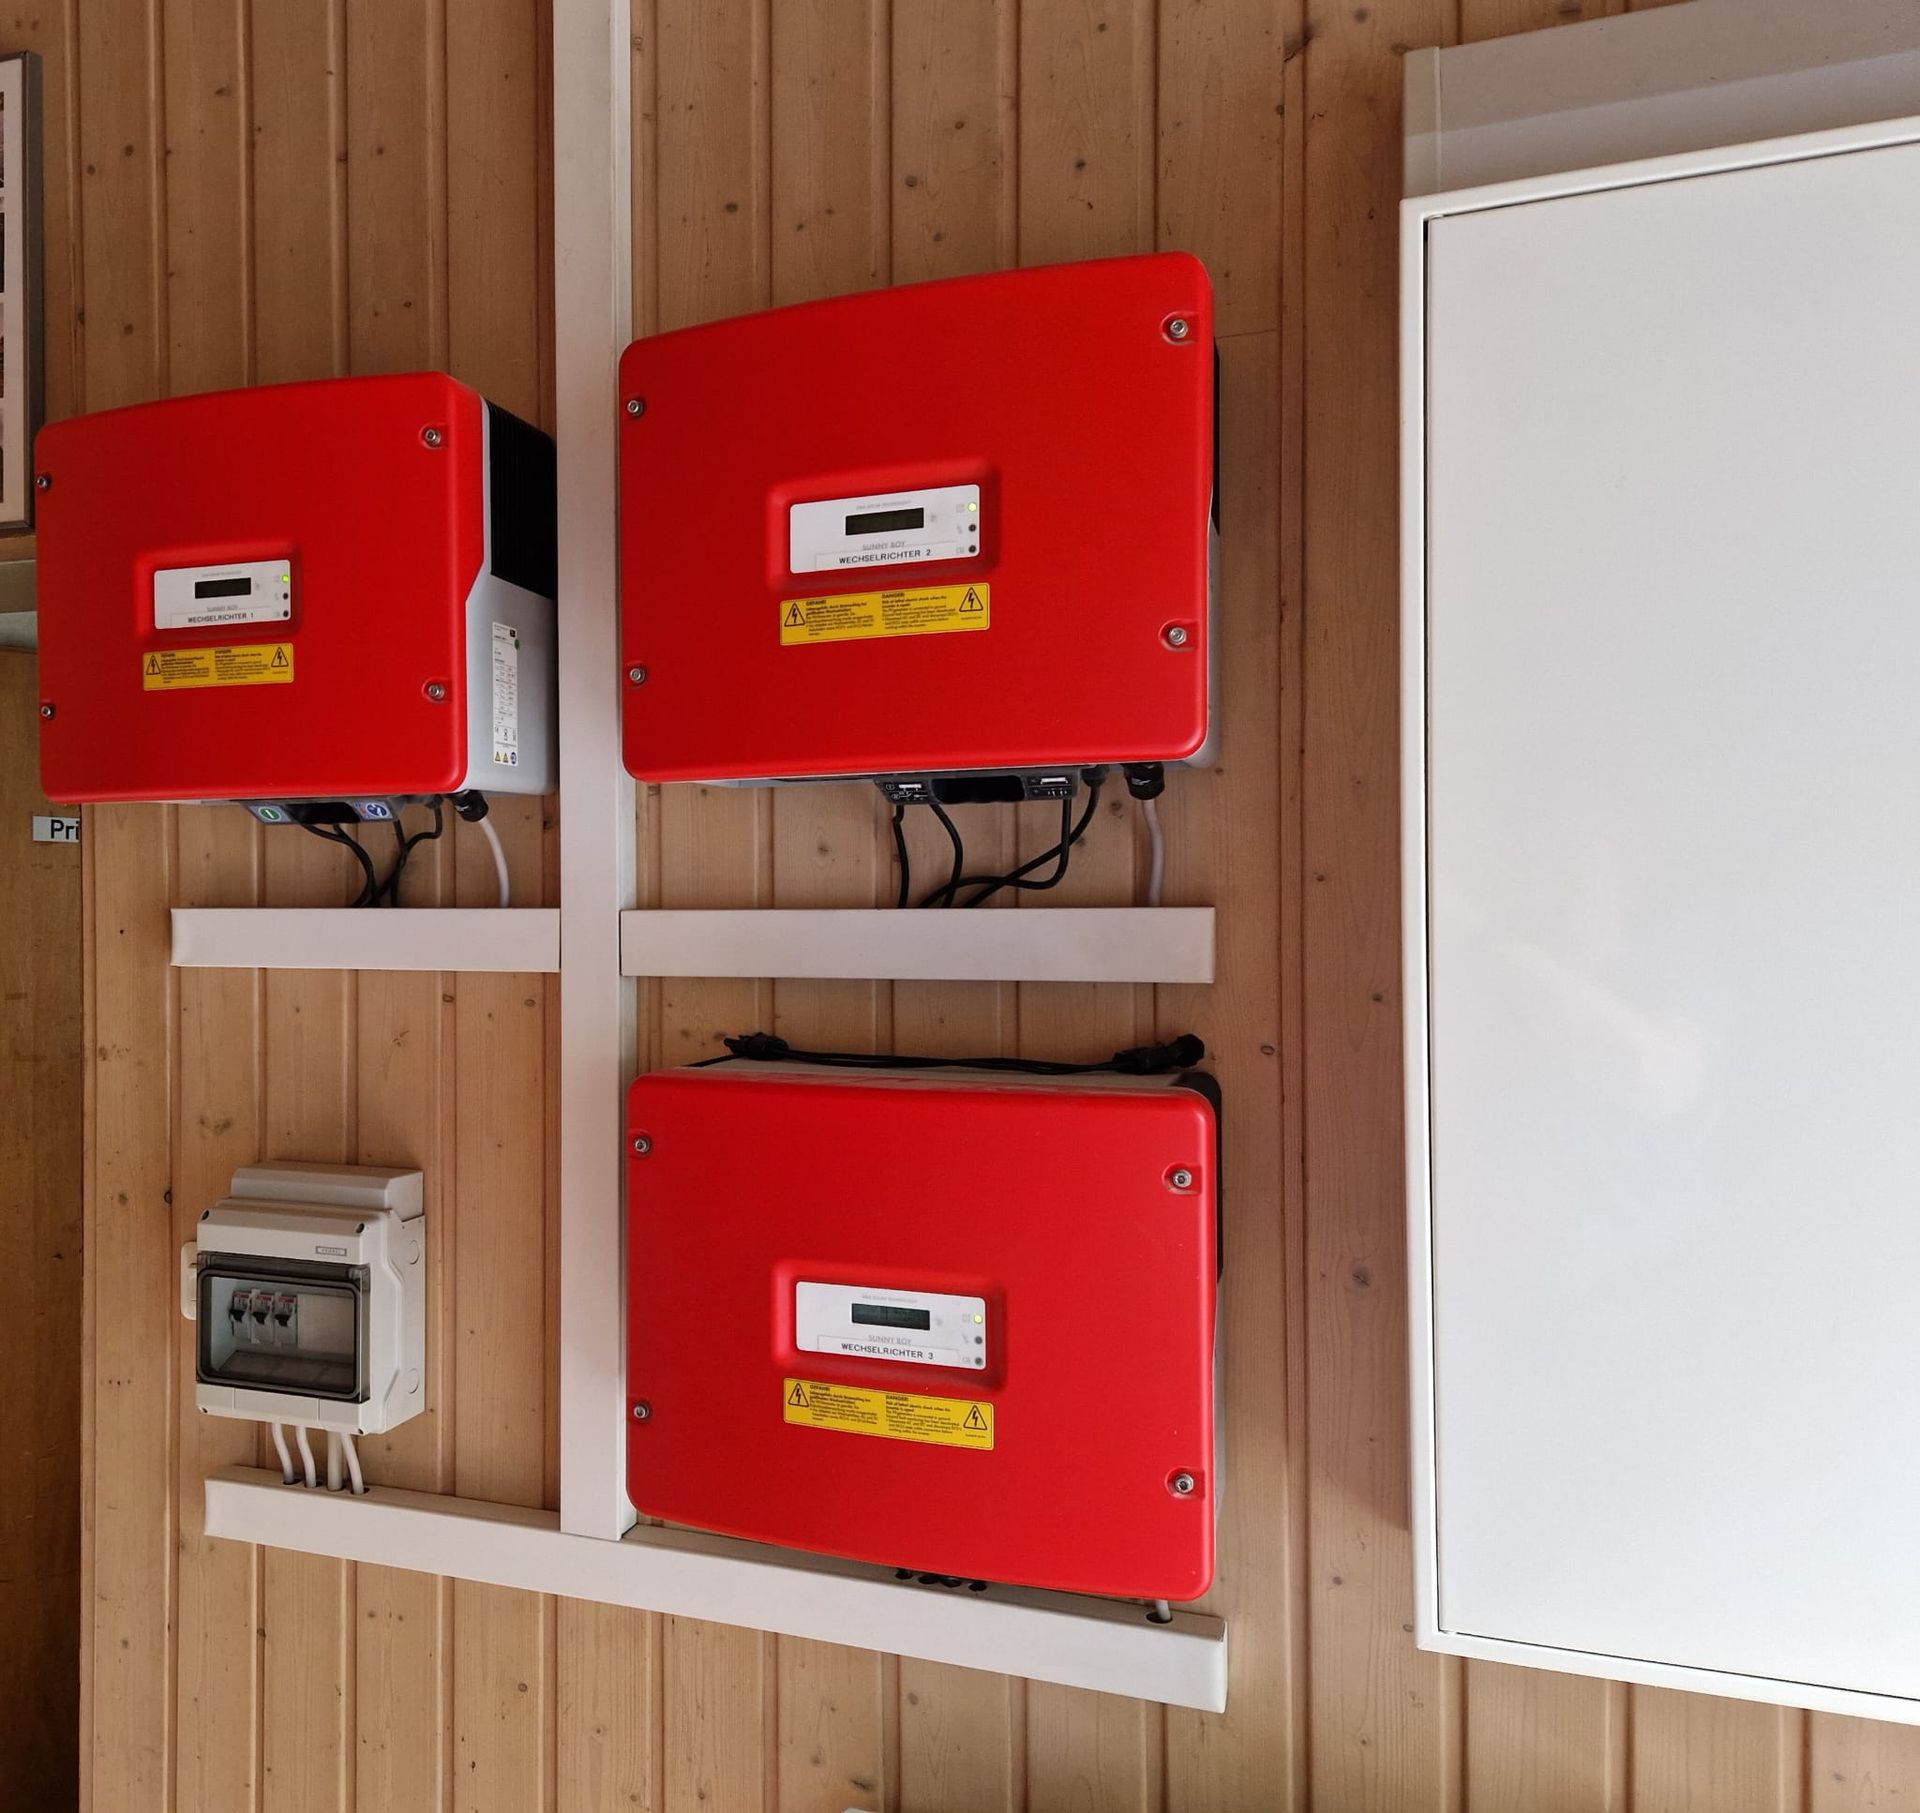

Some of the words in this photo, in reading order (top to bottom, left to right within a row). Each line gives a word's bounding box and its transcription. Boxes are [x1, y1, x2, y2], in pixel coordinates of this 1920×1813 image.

[839, 550, 921, 564] WECHSELRICHTER
[188, 613, 247, 623] WECHSELRICHTER
[51, 819, 80, 840] Pri
[868, 1334, 894, 1343] SUNNY
[896, 1337, 912, 1345] BOY
[841, 1343, 923, 1358] WECHSELRICHTER
